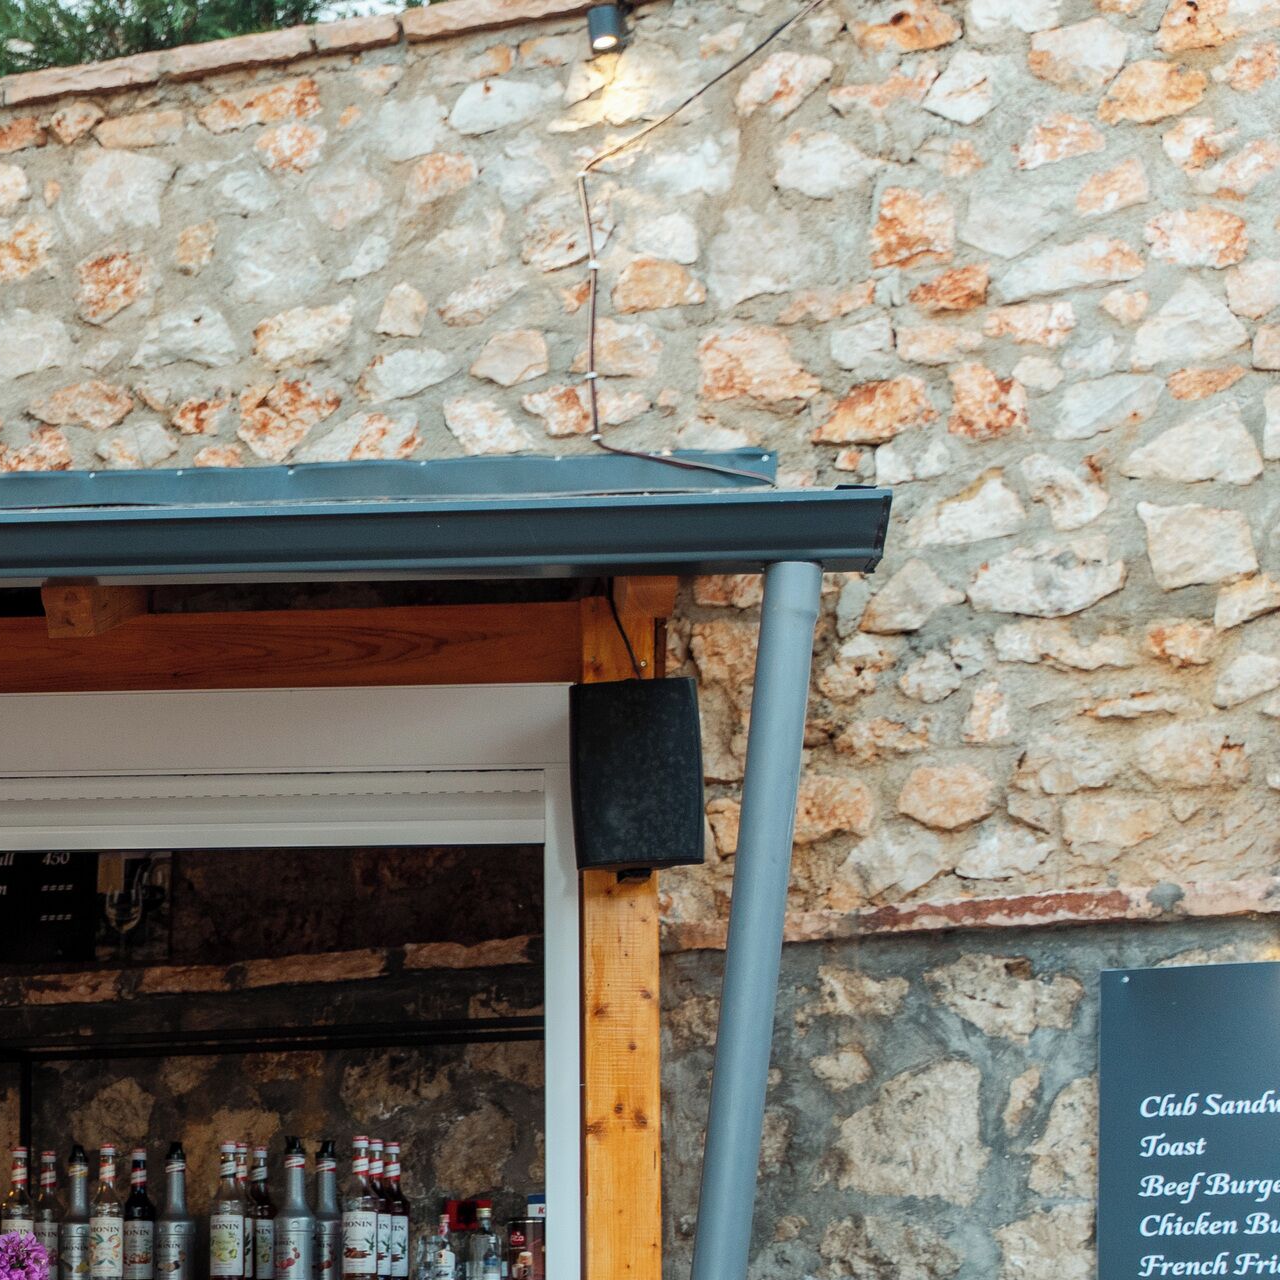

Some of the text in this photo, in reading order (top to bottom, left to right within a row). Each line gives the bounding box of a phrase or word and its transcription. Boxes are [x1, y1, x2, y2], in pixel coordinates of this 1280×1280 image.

[42, 852, 70, 865] 450
[1139, 1092, 1200, 1118] Club
[1139, 1132, 1208, 1158] Toast
[1137, 1172, 1206, 1204] Beef
[1139, 1211, 1239, 1237] Chicken
[1138, 1251, 1231, 1277] French
